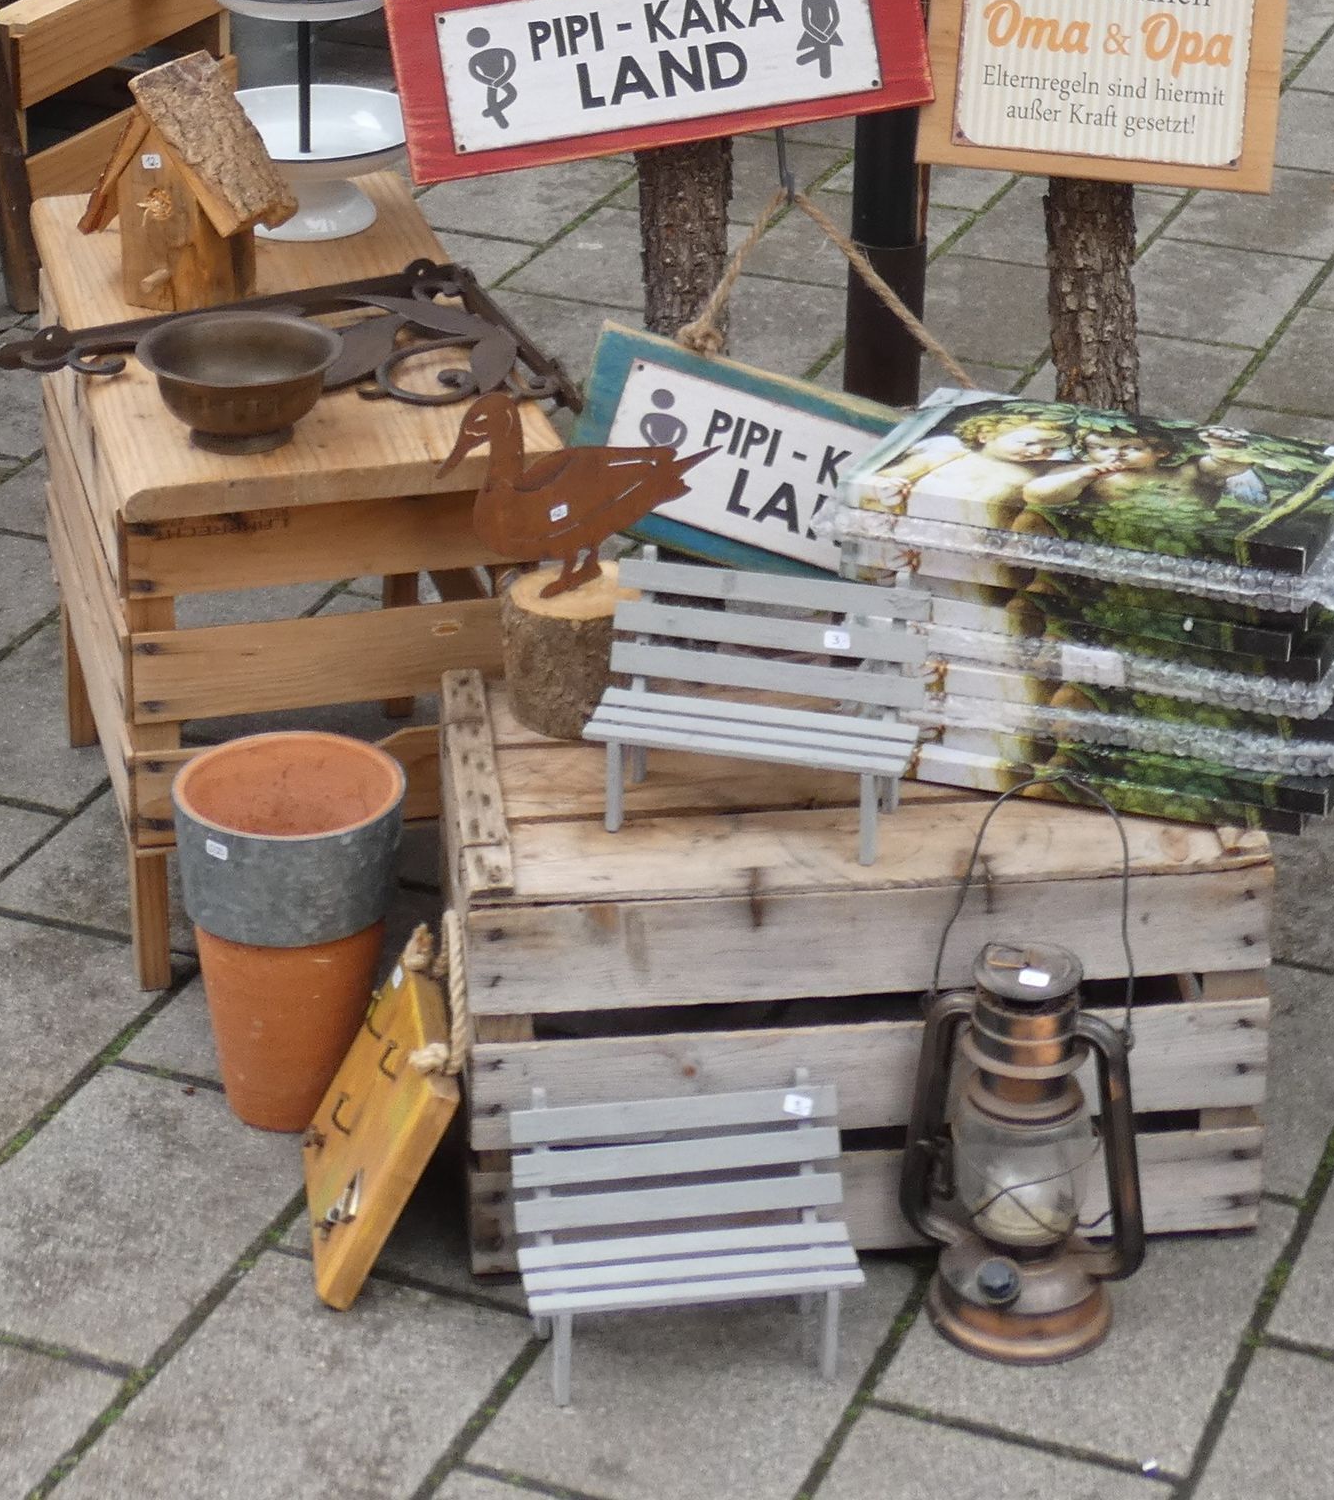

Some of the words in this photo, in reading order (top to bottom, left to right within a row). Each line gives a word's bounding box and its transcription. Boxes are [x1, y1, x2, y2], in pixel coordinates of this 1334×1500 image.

[528, 11, 605, 61] PIPI
[1103, 23, 1132, 56] &
[1141, 12, 1235, 78] Opa
[576, 41, 749, 110] LAND
[983, 65, 1100, 102] Elternregeln
[1107, 77, 1147, 101] sind
[1155, 78, 1226, 107] hiermit
[1006, 99, 1061, 124] außer
[1069, 103, 1119, 128] Kraft
[1124, 114, 1197, 138] gesetzt!
[703, 408, 783, 467] PIPI
[726, 467, 841, 547] LA
